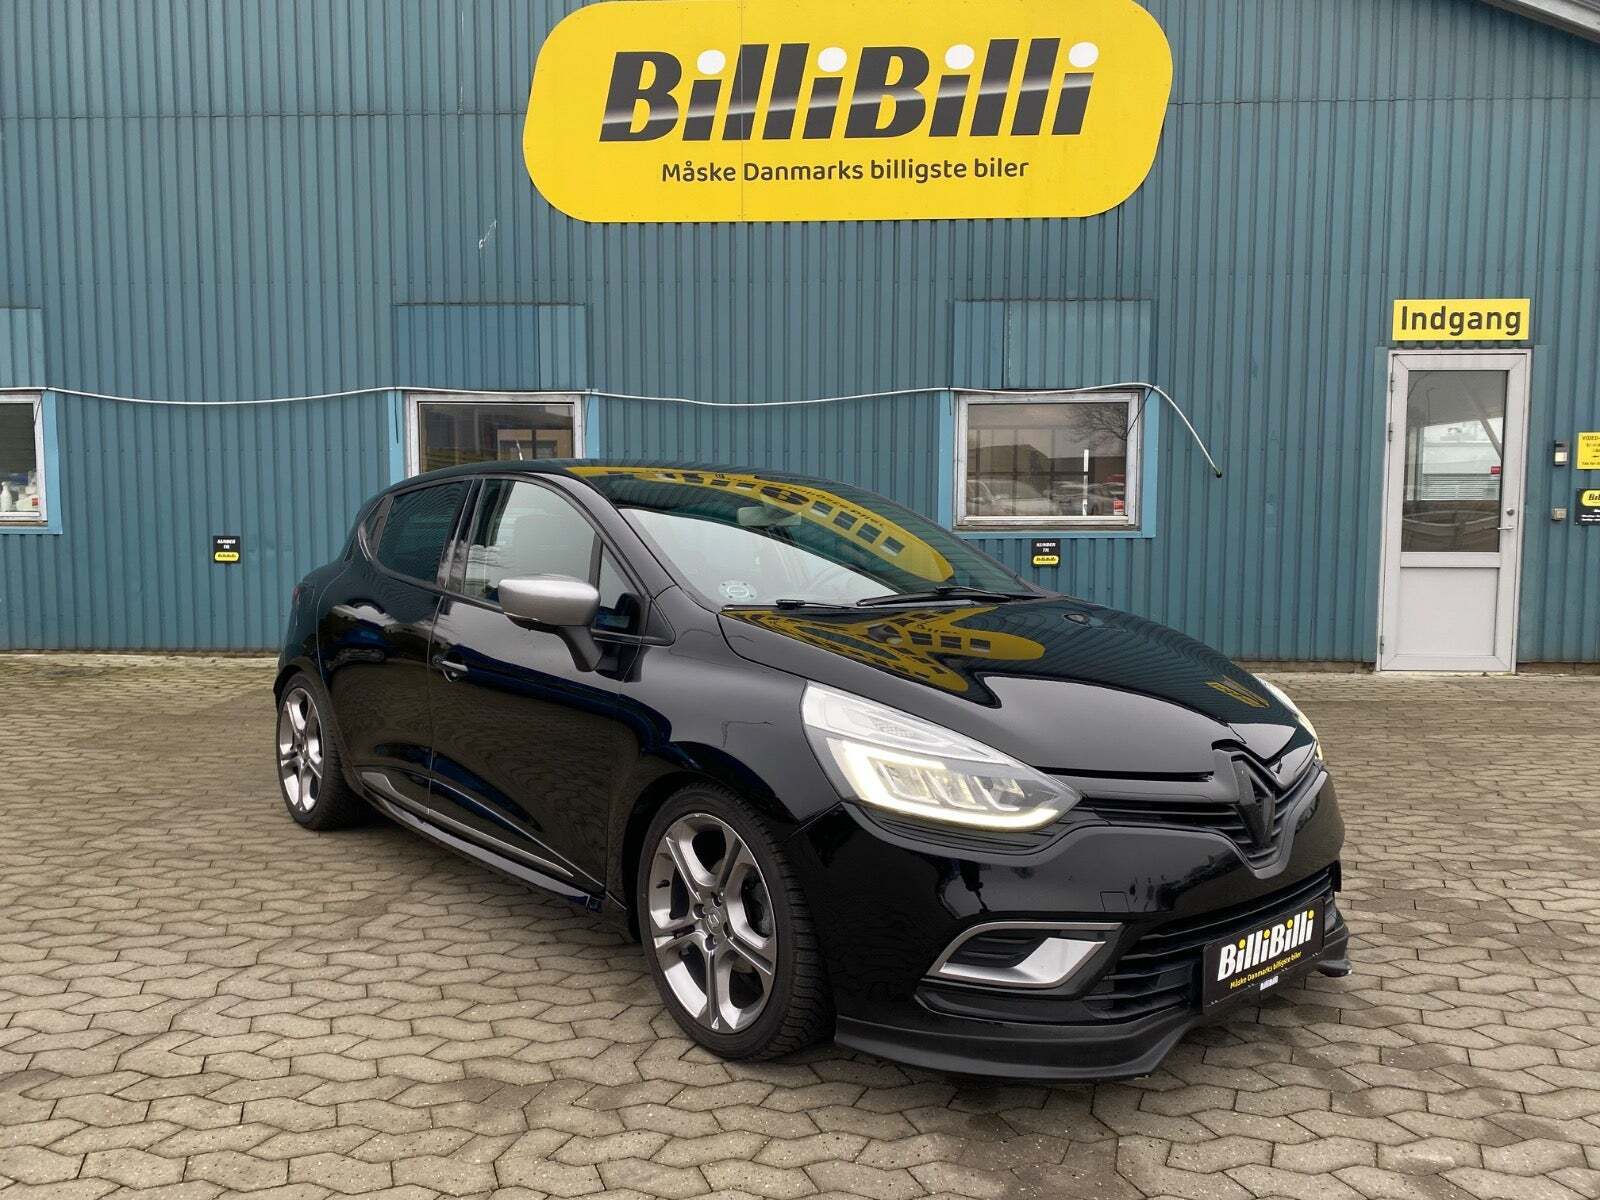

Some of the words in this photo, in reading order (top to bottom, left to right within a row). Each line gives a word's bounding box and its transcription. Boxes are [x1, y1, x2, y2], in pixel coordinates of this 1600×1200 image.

[599, 38, 1100, 142] BilliBilli
[661, 161, 736, 182] Måske
[743, 159, 864, 181] Danmarks
[870, 158, 967, 184] billigste
[973, 157, 1029, 178] biler
[1401, 305, 1521, 336] Indgang
[1217, 910, 1314, 981] BilliBilli
